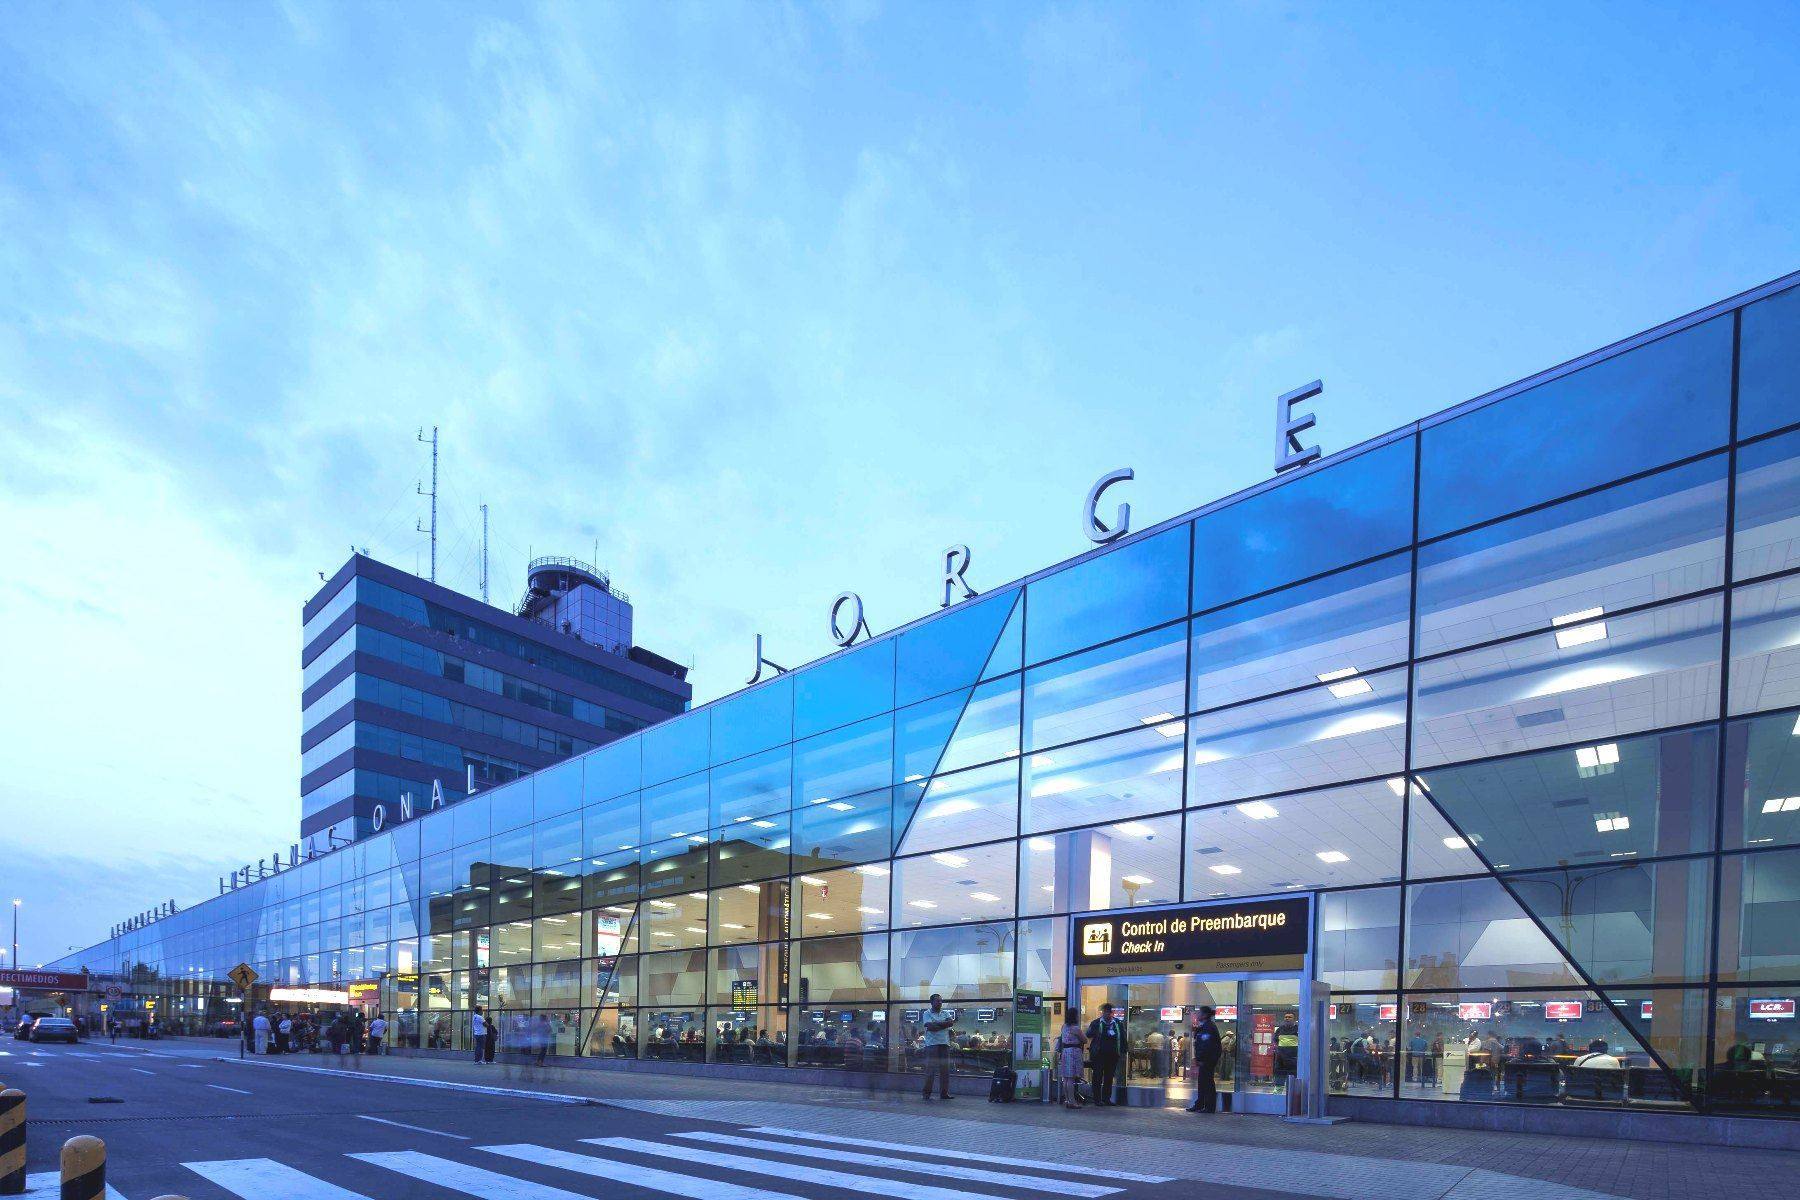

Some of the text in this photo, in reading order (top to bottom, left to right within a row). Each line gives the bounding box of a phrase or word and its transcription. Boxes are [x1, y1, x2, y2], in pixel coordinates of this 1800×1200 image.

[745, 379, 1323, 685] JORGE
[1121, 911, 1286, 937] Control de Preembarque
[1121, 940, 1165, 954] Check In
